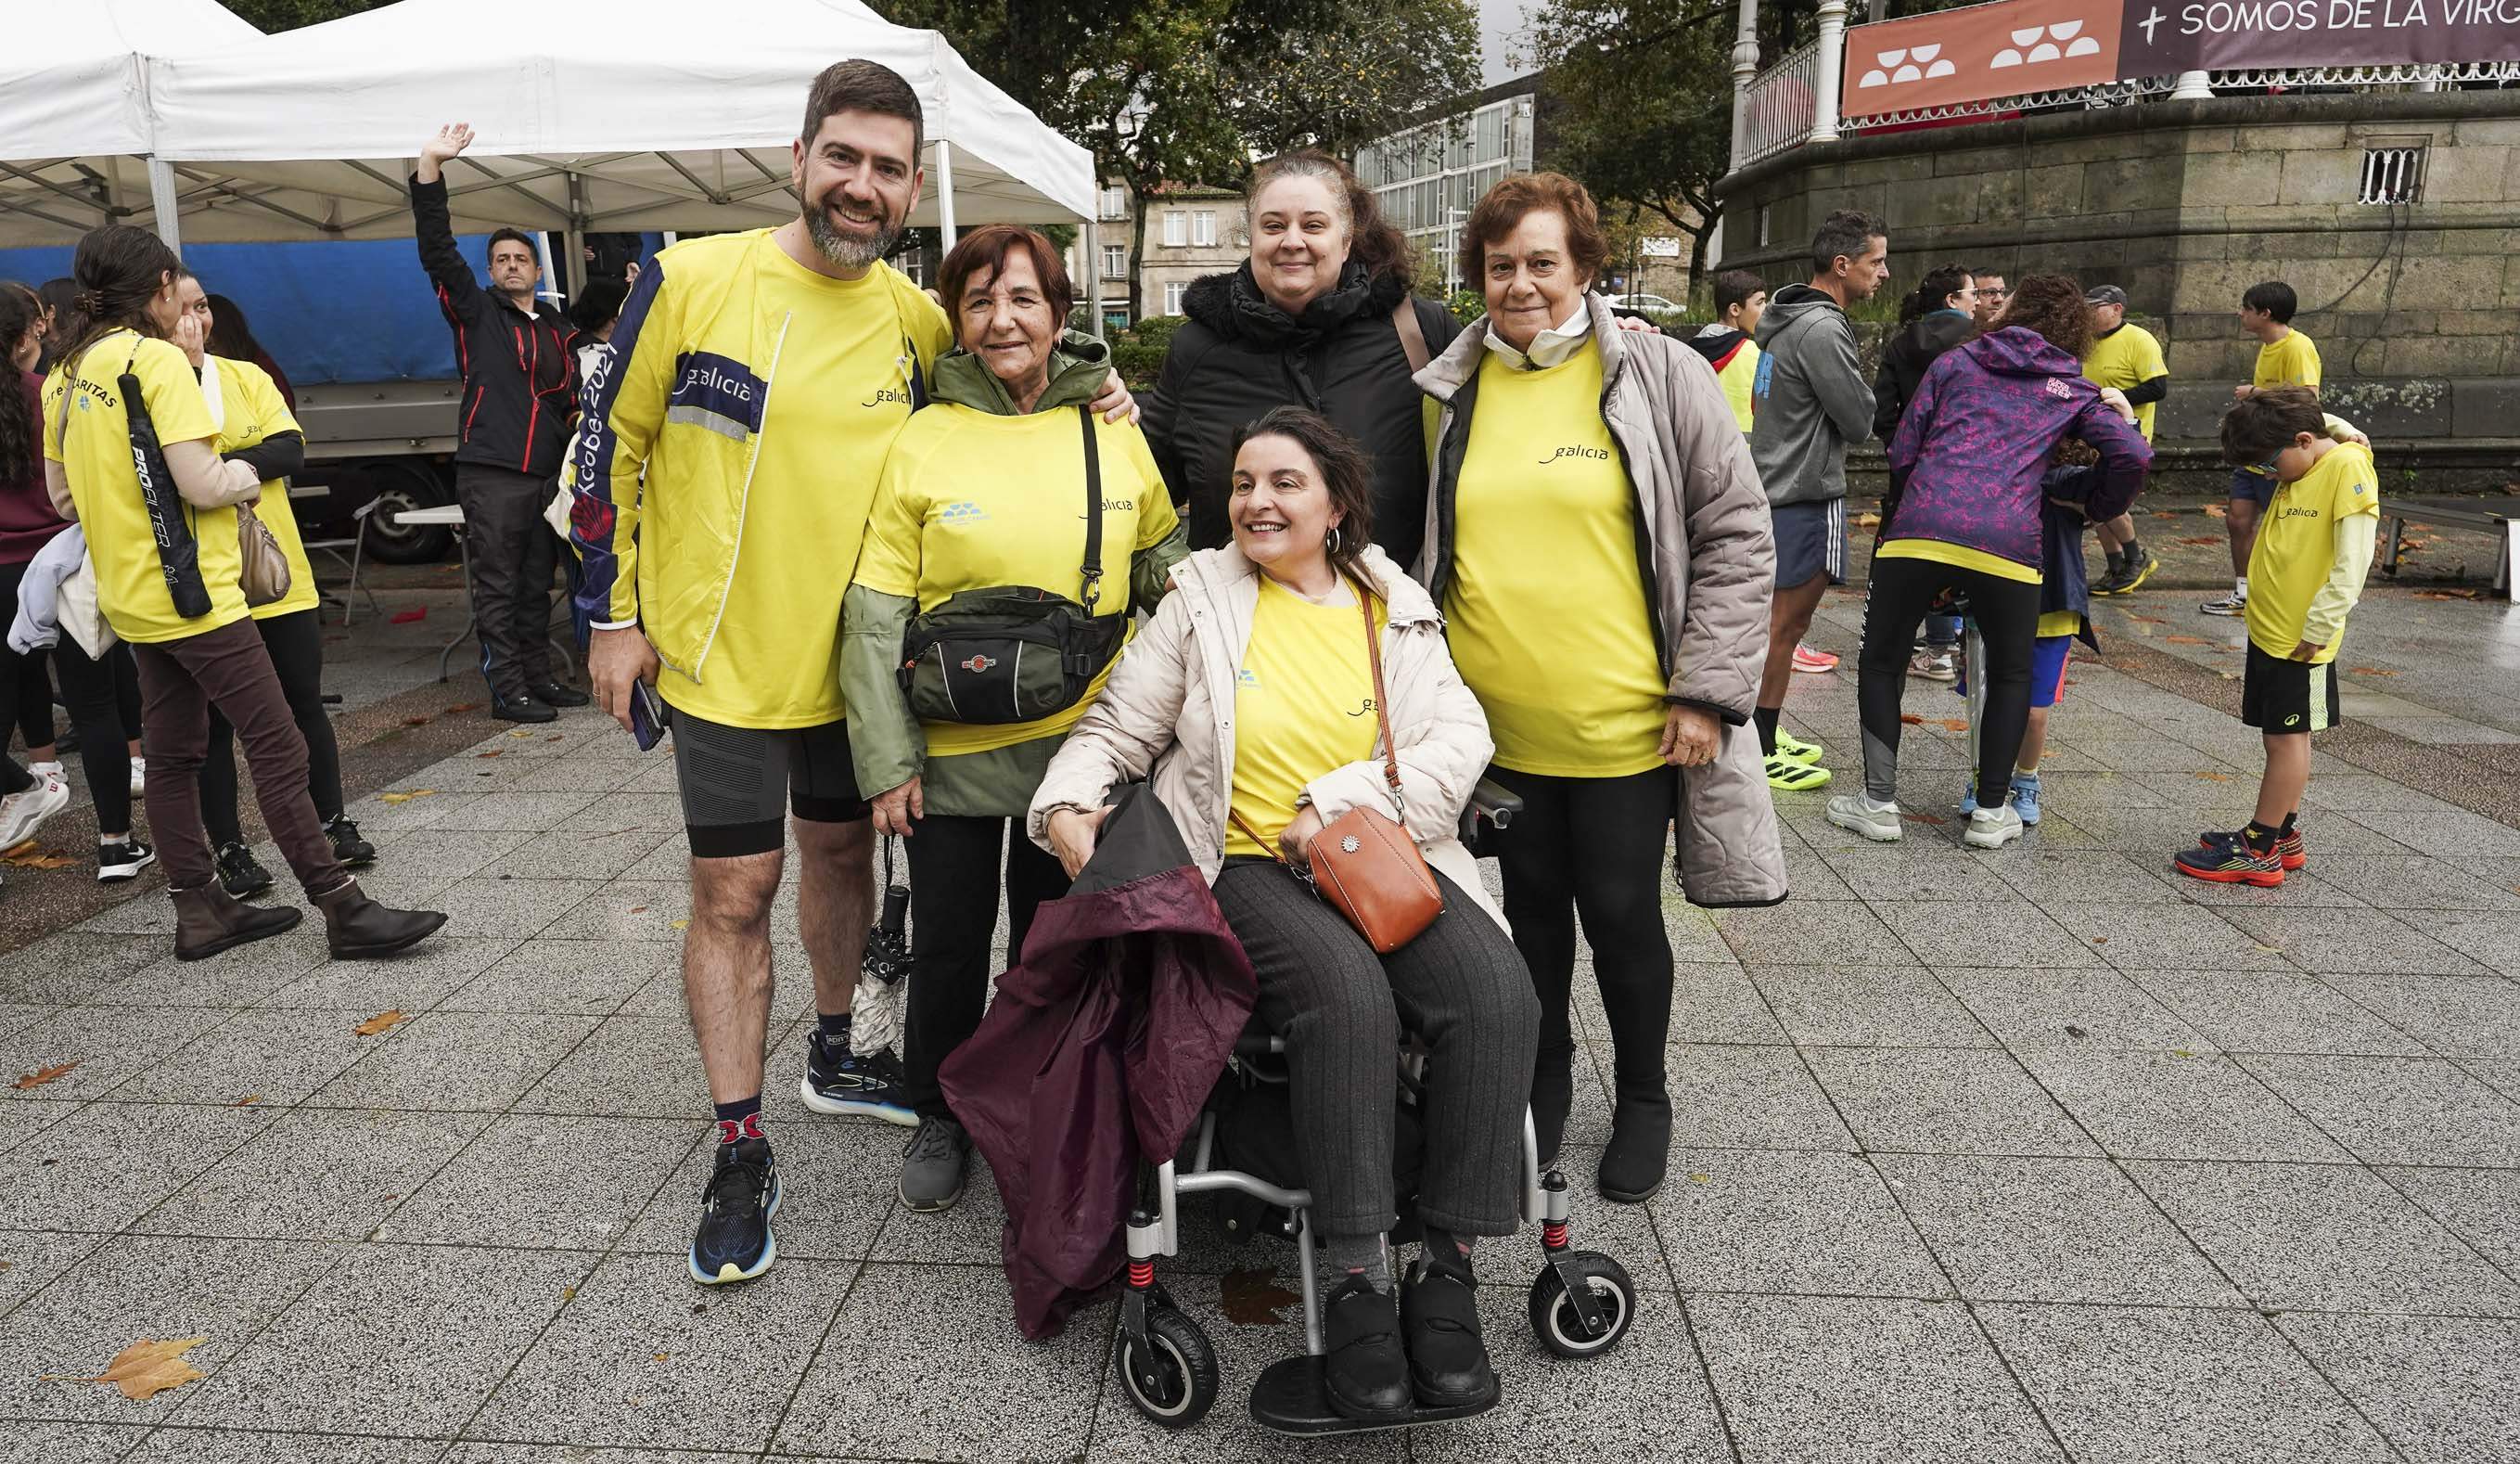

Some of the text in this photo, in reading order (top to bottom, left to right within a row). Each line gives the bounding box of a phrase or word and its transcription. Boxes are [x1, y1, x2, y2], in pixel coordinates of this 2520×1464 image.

[2180, 1, 2318, 34] SOMOS
[2327, 0, 2373, 30] DE
[2383, 0, 2428, 28] LA
[583, 341, 618, 407] 2021
[672, 366, 750, 402] galicia
[73, 378, 118, 408] ARITAS
[861, 388, 911, 408] galici
[1539, 444, 1609, 464] galicia
